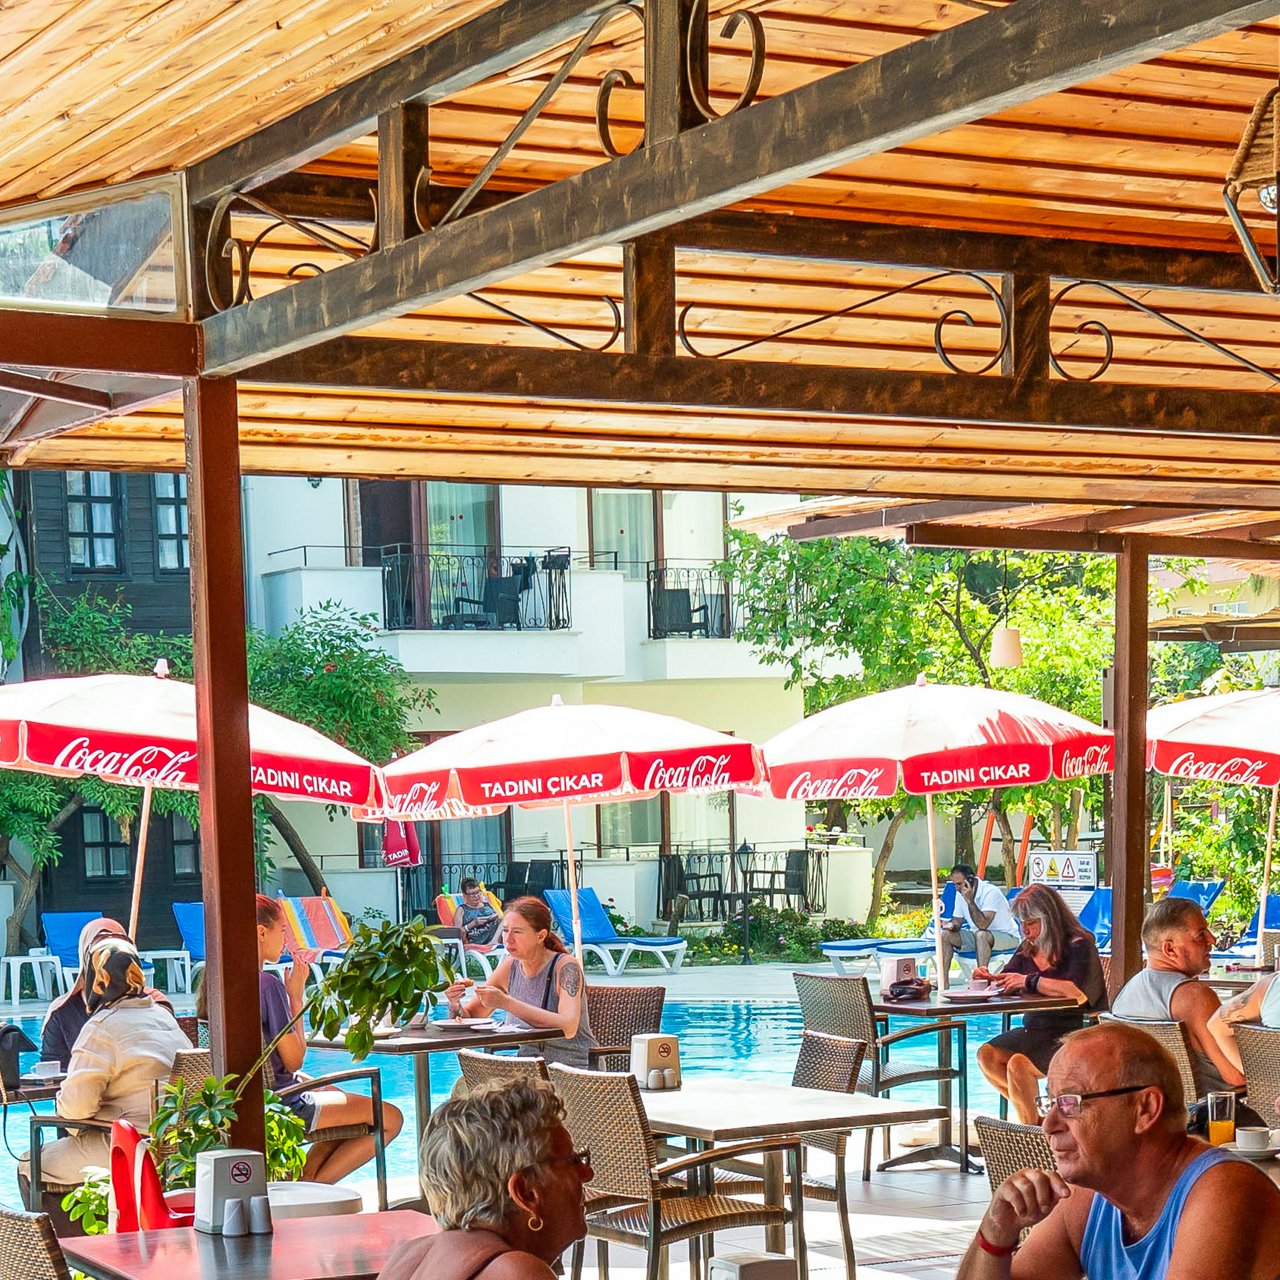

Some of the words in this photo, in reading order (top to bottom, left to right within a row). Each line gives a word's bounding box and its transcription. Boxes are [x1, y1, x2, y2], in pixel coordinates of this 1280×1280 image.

[54, 737, 198, 782] Coca-Cola
[644, 754, 731, 790] Coca-Cola
[920, 768, 974, 786] TADINI
[978, 763, 1031, 784] ÇIKAR
[1170, 752, 1268, 785] Coca-Cola
[303, 775, 352, 797] ÇIKAR
[481, 778, 543, 798] TADINI
[547, 773, 604, 795] ÇIKAR
[785, 768, 886, 799] Coca-Cola
